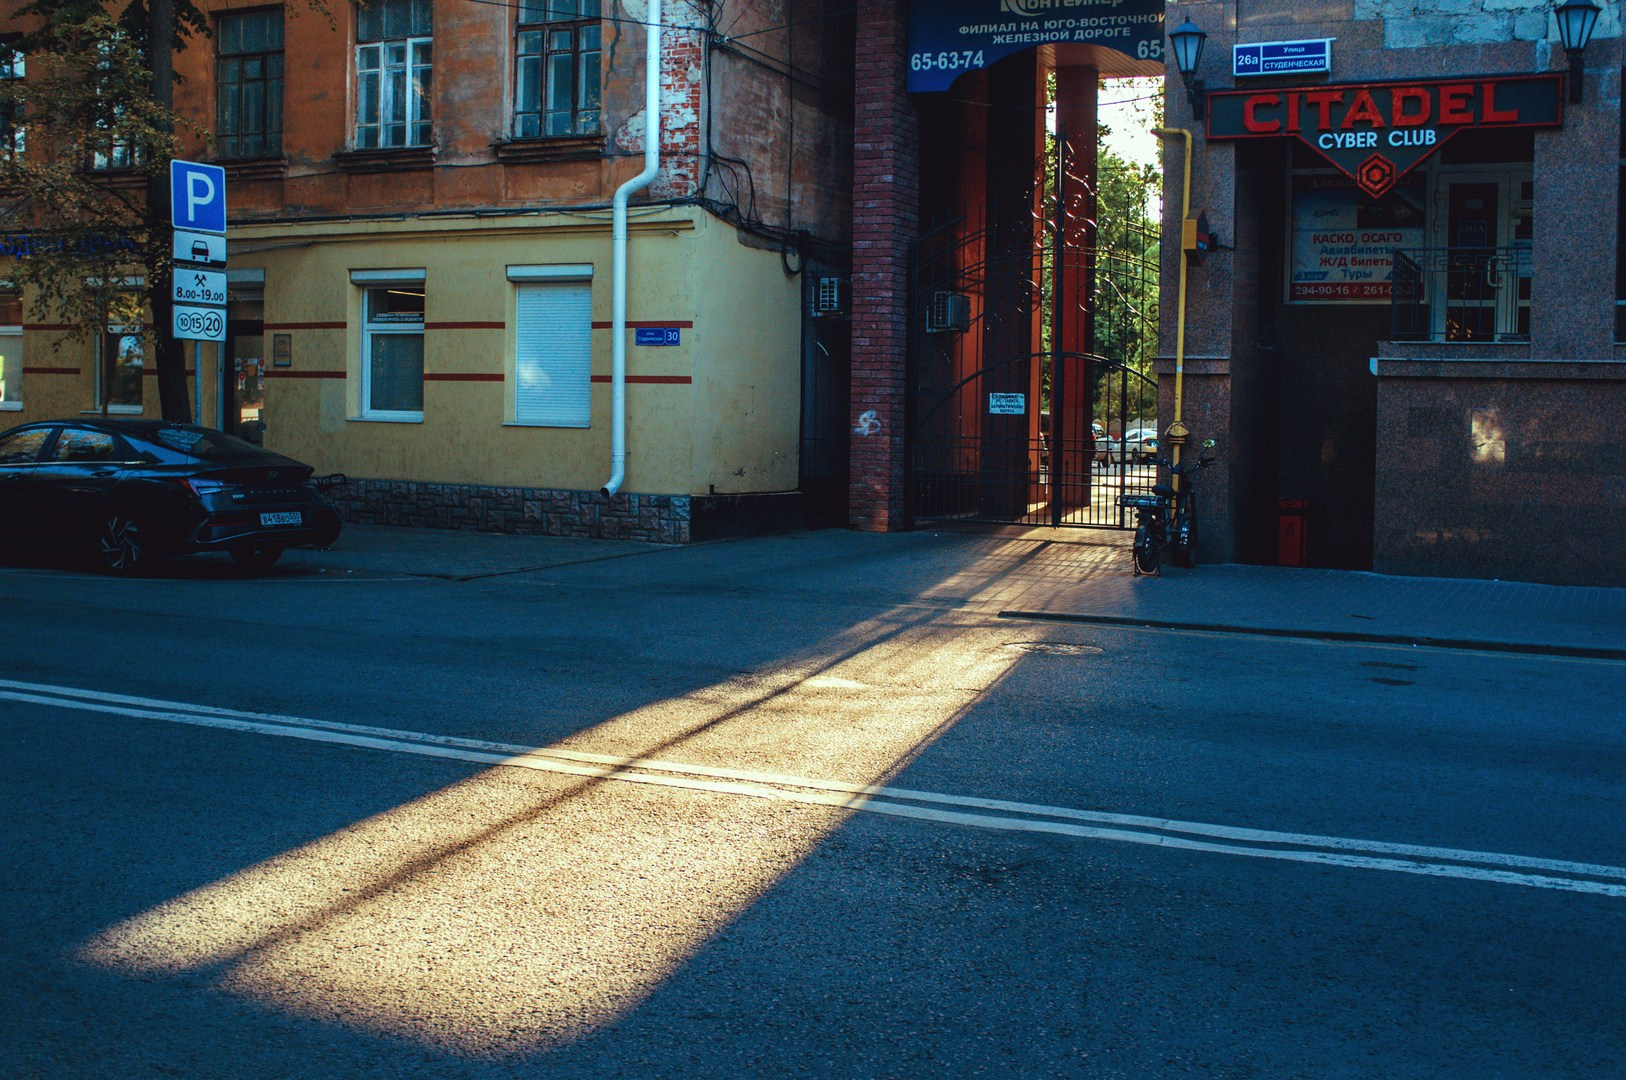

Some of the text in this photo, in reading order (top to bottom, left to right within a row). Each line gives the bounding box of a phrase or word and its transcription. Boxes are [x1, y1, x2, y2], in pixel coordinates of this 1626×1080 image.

[959, 23, 1016, 35] ФИЛИАЛ
[1020, 21, 1039, 31] НА
[993, 27, 1131, 44] ЖЕЛЕЗНОЙ ДОРОГЕ
[911, 50, 984, 71] 65-63-74
[1237, 54, 1259, 66] 26а
[1264, 59, 1325, 70] СТУДЕНЧЕСКАЯ
[1243, 83, 1518, 132] CITADEL
[1318, 129, 1436, 150] CYBER CLUB
[186, 171, 215, 222] P
[1313, 232, 1403, 245] КАСКО, ОСАГО
[1319, 257, 1348, 268] Ж/Д
[1341, 268, 1373, 280] Туры
[176, 287, 224, 301] 8.00-19.00
[180, 317, 220, 332] 10 15 20
[667, 331, 678, 341] 30
